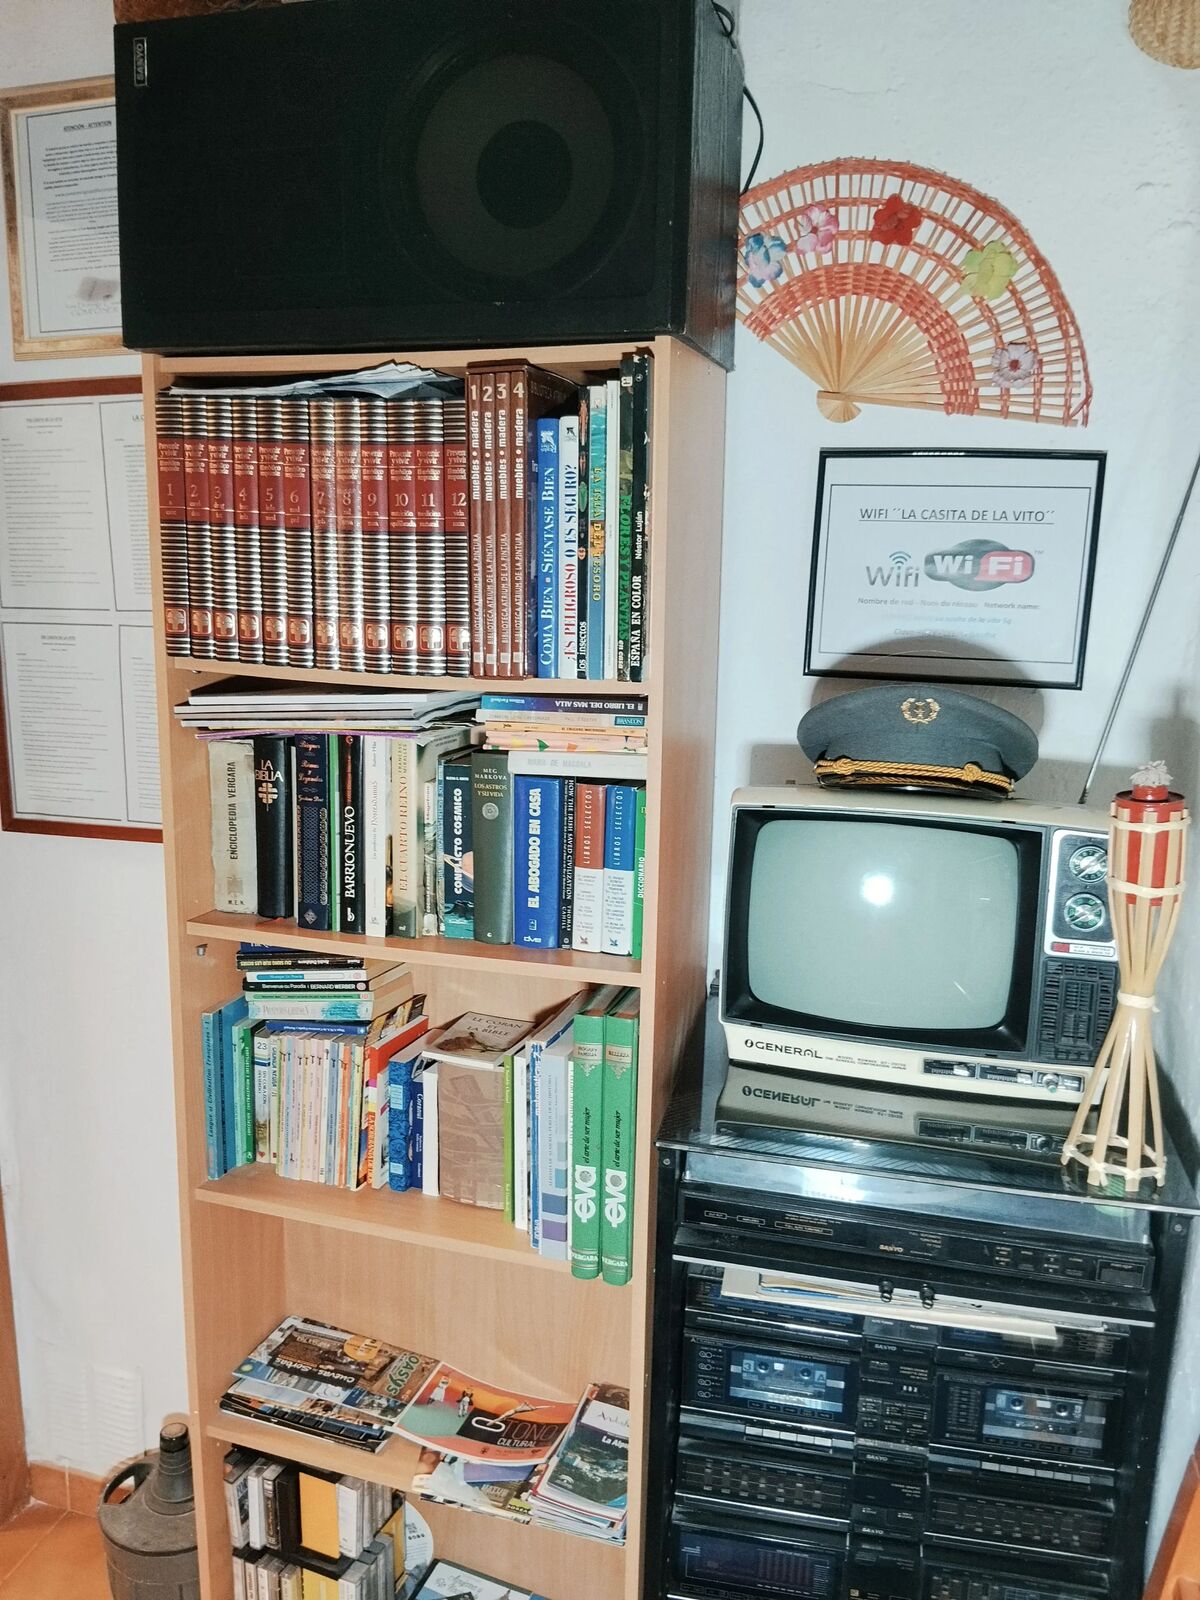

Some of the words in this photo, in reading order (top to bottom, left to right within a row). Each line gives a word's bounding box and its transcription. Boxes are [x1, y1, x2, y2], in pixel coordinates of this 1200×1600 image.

[136, 43, 144, 81] SANYO
[471, 385, 477, 400] 1
[483, 386, 493, 401] 2
[497, 384, 507, 399] 3
[513, 382, 525, 398] 4
[471, 410, 479, 448] madera
[484, 411, 492, 450] madera
[498, 409, 506, 447] madera
[515, 408, 523, 446] madera
[472, 459, 480, 500] muebles
[485, 460, 493, 501] muebles
[515, 458, 523, 499] muebles
[542, 467, 555, 501] BIEN
[593, 467, 602, 484] LA
[167, 483, 174, 497] 1
[190, 484, 198, 497] 2
[214, 486, 222, 499] 3
[238, 488, 247, 501] 4
[265, 488, 273, 501] 5
[290, 490, 299, 503] 6
[317, 491, 325, 505] 7
[342, 491, 351, 505] 8
[564, 464, 577, 523] SEGURO?
[367, 493, 377, 506] 9
[395, 493, 409, 507] 10
[421, 493, 436, 507] 11
[452, 493, 467, 507] 12
[593, 490, 602, 518] ISLA
[859, 508, 888, 519] WIFI
[921, 509, 967, 521] CASITA
[971, 510, 988, 521] DE
[992, 510, 1008, 521] LA
[541, 506, 555, 574] SIÉNTASE
[564, 528, 577, 543] ES
[593, 523, 602, 548] DEL
[564, 549, 577, 557] O
[515, 562, 522, 570] LA
[487, 574, 493, 583] DE
[515, 572, 522, 580] DE
[592, 553, 602, 601] TESORO
[865, 565, 920, 588] Wifi
[564, 563, 577, 636] PELIGROSO
[631, 575, 642, 609] COLOR
[541, 587, 553, 619] BIEN
[857, 597, 888, 605] Nombre
[984, 601, 1015, 609] Network
[631, 612, 641, 625] EN
[540, 624, 553, 665] COMA
[579, 621, 587, 655] insectos
[564, 639, 577, 662] ¿ES
[260, 759, 273, 770] LA
[227, 761, 237, 798] VERGARA
[399, 776, 408, 818] REINO
[528, 787, 541, 816] CASA
[453, 788, 463, 834] COSMICO
[584, 790, 592, 829] SELECTOS
[614, 790, 623, 831] SELECTOS
[229, 800, 238, 861] ENCICLOPEDIA
[528, 819, 541, 835] EN
[344, 806, 356, 899] BARRIONUEVO
[399, 821, 408, 872] CUARTO
[583, 835, 591, 864] LIBROS
[613, 836, 621, 866] LIBROS
[453, 838, 463, 895] CONFLICTO
[528, 838, 541, 893] ABOGADO
[399, 874, 408, 892] EL
[637, 856, 645, 899] DICCIONARIO
[527, 896, 540, 909] EL
[485, 1020, 523, 1029] CORAN
[257, 1042, 267, 1050] 23
[755, 1041, 823, 1060] GENERAL
[582, 1107, 592, 1125] mujer
[613, 1110, 622, 1129] mujer
[582, 1136, 590, 1144] de
[613, 1139, 620, 1148] de
[582, 1156, 590, 1164] el
[612, 1160, 620, 1168] el
[574, 1165, 597, 1223] eva
[604, 1168, 627, 1228] eva
[879, 1243, 904, 1253] SANYO
[572, 1253, 599, 1262] VERGARA
[601, 1256, 628, 1267] VERGARA
[874, 1343, 897, 1351] SANYO
[497, 1438, 537, 1448] CULTURAL
[601, 1435, 612, 1444] La
[866, 1454, 889, 1462] SANYO
[862, 1527, 884, 1535] SANYO
